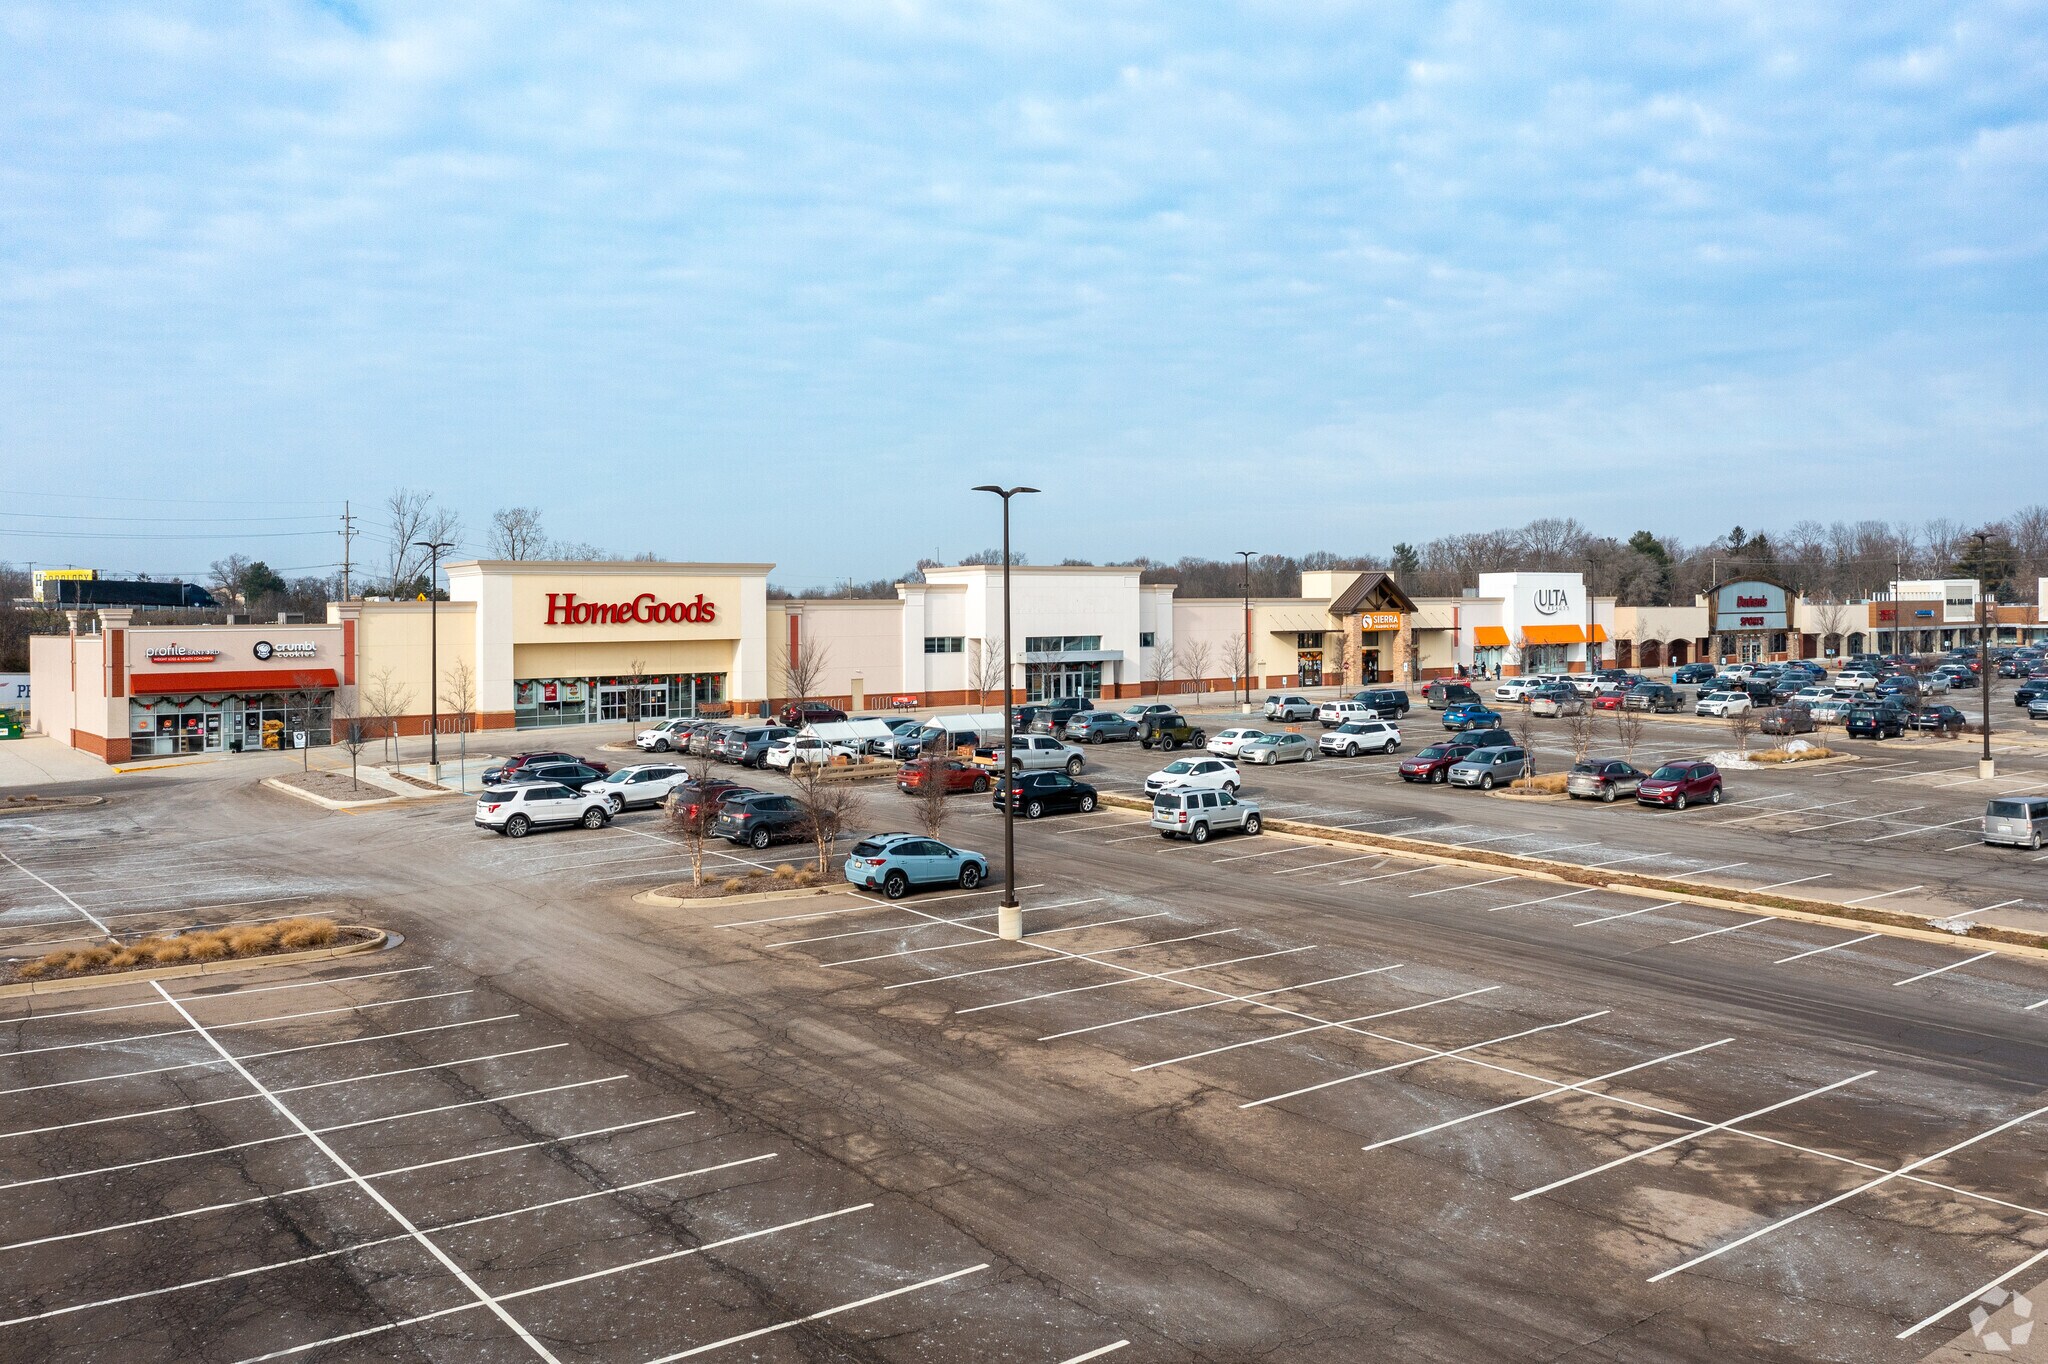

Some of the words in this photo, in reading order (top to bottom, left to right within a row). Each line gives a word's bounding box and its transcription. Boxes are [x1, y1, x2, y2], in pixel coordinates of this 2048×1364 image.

[1538, 589, 1568, 606] ULTA
[544, 593, 716, 625] HomeGoods
[1373, 615, 1399, 624] SIERRA
[1740, 616, 1765, 627] SPORTS
[146, 643, 186, 659] profile
[275, 641, 317, 651] crumbl
